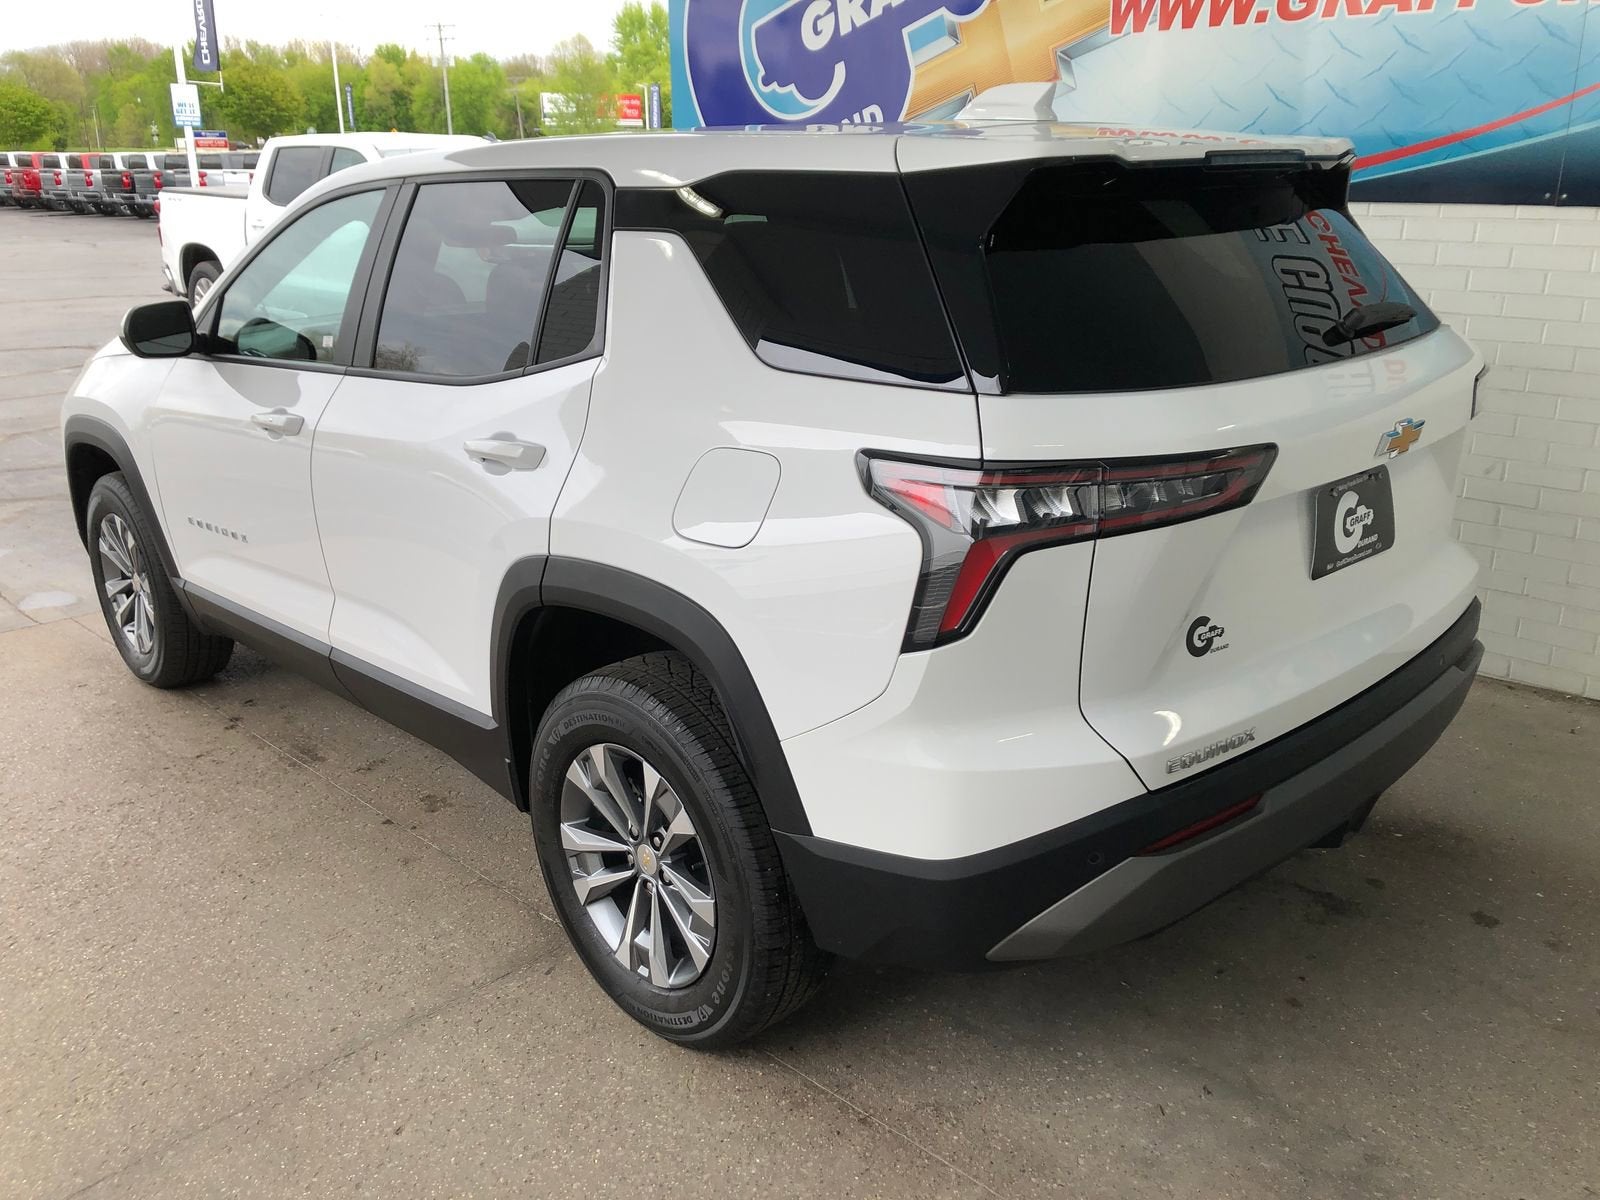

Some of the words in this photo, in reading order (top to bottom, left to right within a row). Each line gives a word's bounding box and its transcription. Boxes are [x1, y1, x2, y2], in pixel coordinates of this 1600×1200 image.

[1350, 511, 1372, 528] GRAFF
[1357, 533, 1379, 549] DURAND
[1200, 628, 1223, 640] GRAFF
[1166, 726, 1256, 774] EQUINOX
